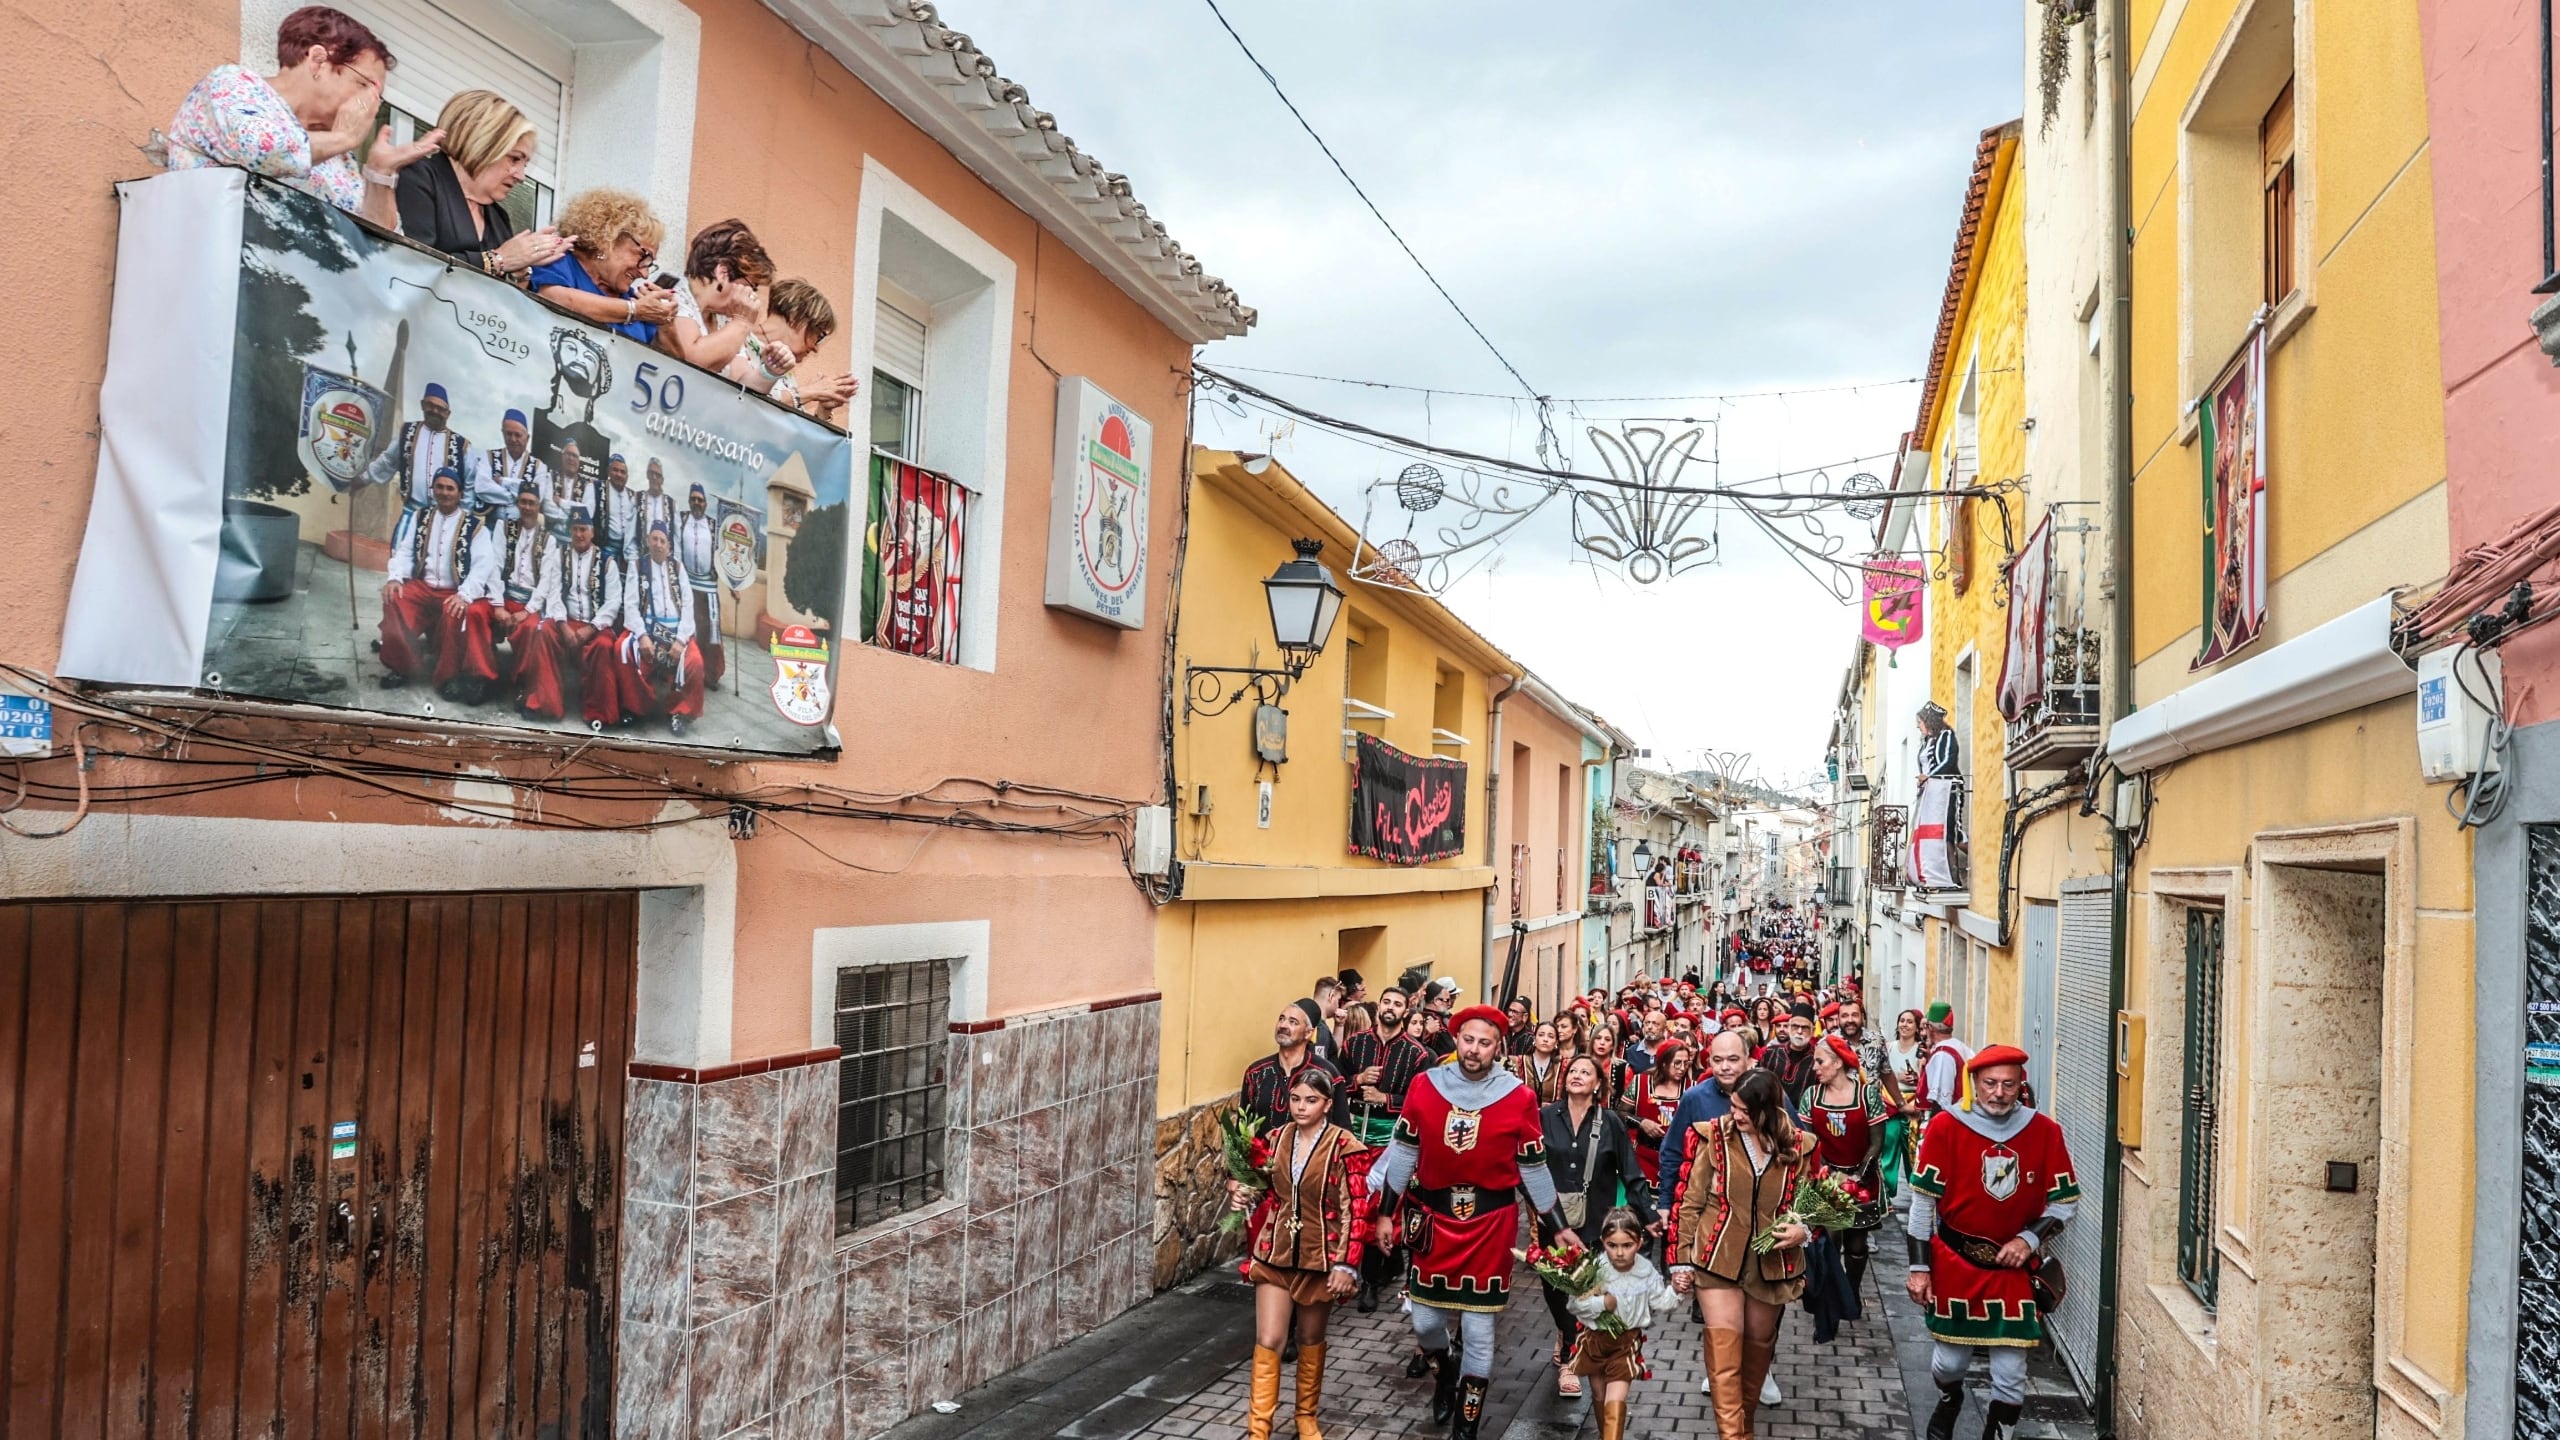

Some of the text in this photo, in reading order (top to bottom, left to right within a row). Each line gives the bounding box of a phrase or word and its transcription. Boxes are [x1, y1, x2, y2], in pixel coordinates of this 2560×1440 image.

[467, 310, 507, 333] 1969
[485, 333, 530, 360] 2019
[631, 361, 685, 411] 50
[646, 411, 764, 471] aniversario
[1077, 552, 1108, 604] HALCONES
[1111, 595, 1124, 606] DEL
[1096, 600, 1121, 616] PETRER
[28, 698, 50, 711] 01
[31, 726, 43, 739] C
[2539, 1002, 2550, 1011] 500
